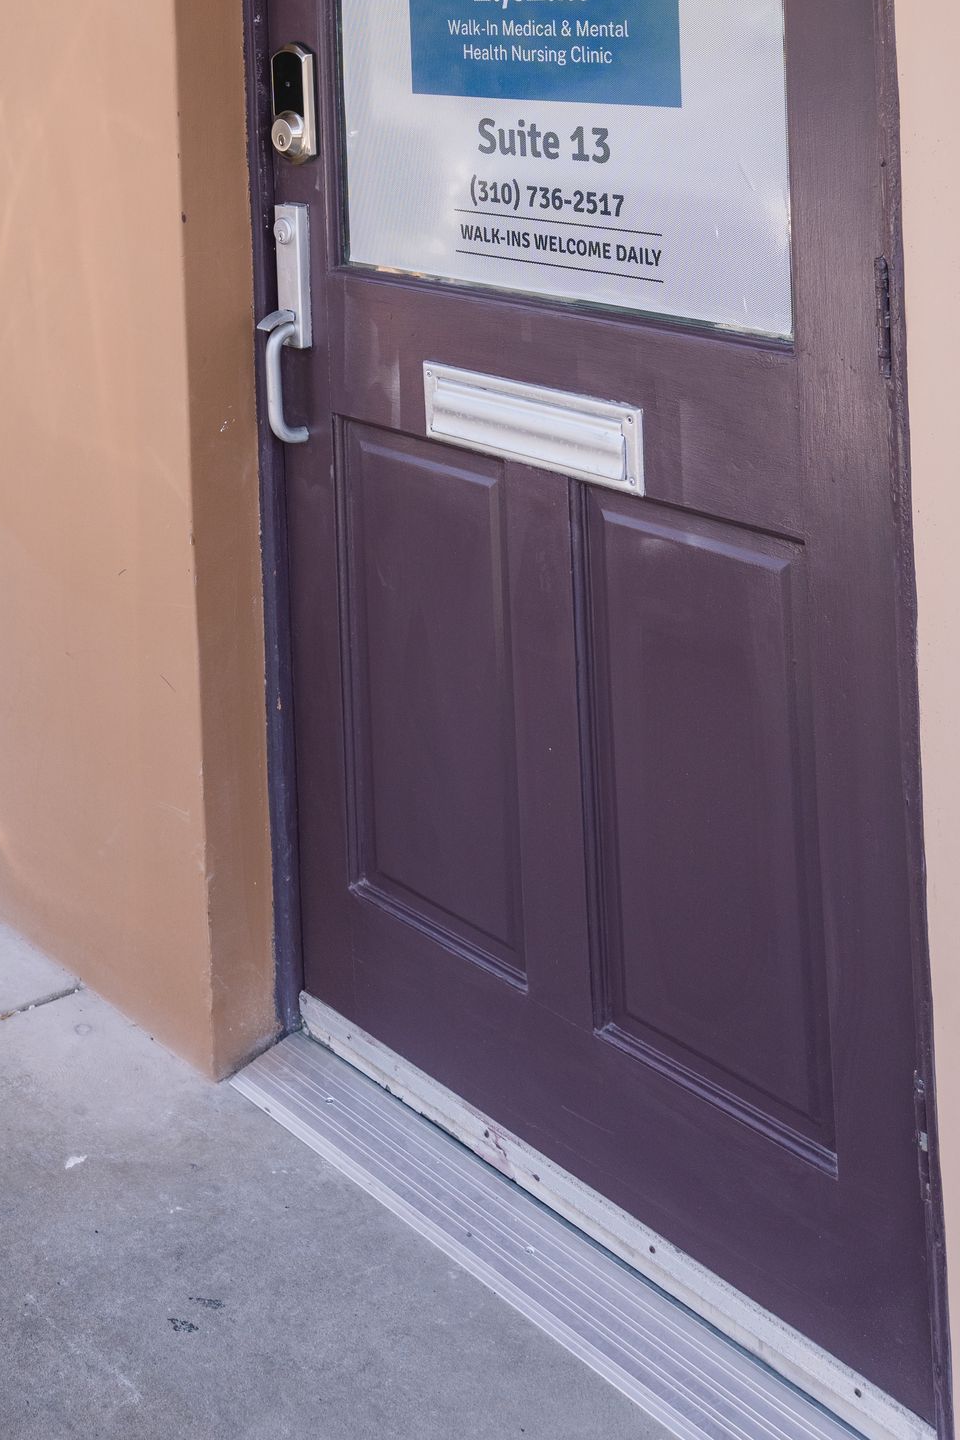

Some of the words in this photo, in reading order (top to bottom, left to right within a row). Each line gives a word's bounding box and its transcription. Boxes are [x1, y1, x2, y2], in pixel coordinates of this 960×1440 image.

[447, 19, 499, 37] Walk-In
[502, 20, 557, 38] Medical
[560, 21, 572, 38] &
[575, 20, 630, 39] Mental
[463, 44, 508, 62] Health
[511, 45, 567, 67] Nursing
[570, 45, 613, 65] Clinic
[478, 117, 560, 160] Suite
[570, 125, 611, 164] 13
[470, 174, 520, 211] (310)
[526, 185, 625, 218] 736-2517
[460, 223, 531, 250] WALK-INS
[534, 233, 612, 260] WELCOME
[616, 243, 662, 267] DAILY
